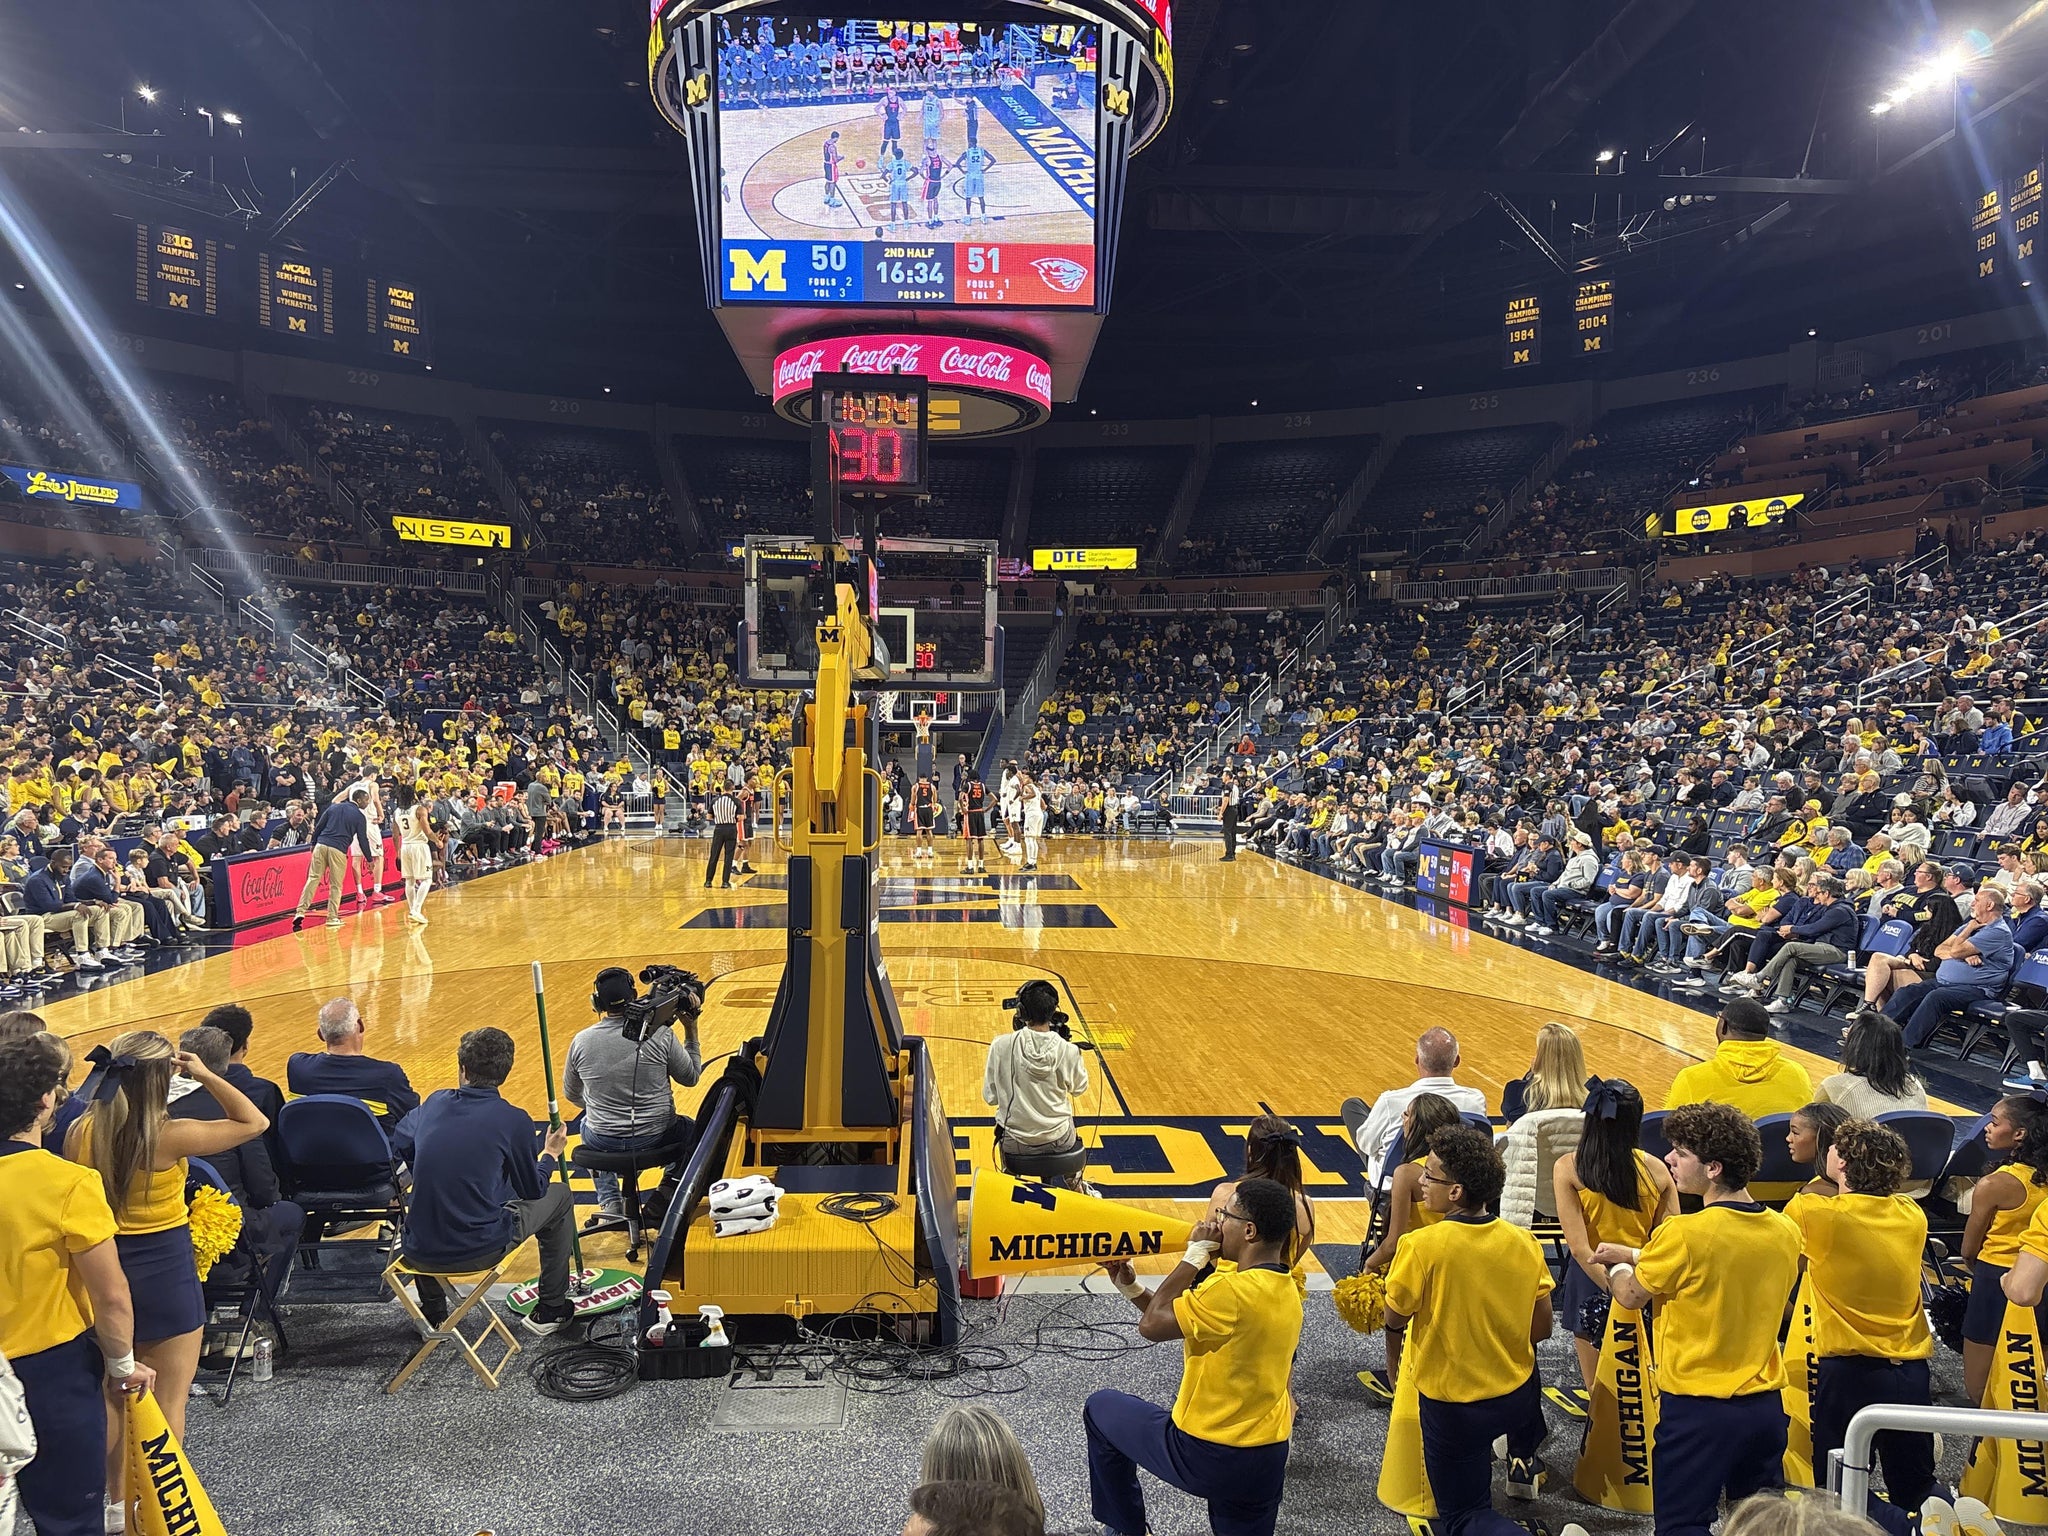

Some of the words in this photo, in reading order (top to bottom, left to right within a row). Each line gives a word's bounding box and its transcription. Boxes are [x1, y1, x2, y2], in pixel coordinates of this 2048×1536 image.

[686, 73, 707, 105] M
[1106, 83, 1130, 116] M
[2015, 210, 2039, 233] 1926
[1977, 231, 1996, 252] 1921
[2017, 239, 2033, 260] M
[157, 244, 199, 261] CHAMPIONS
[811, 246, 847, 271] 50
[884, 248, 905, 258] 2ND
[906, 248, 935, 258] HALF
[967, 247, 1000, 273] 51
[162, 263, 195, 277] WOMEN'S
[282, 261, 312, 276] NCAA
[729, 249, 787, 291] M
[876, 261, 945, 285] 16:34
[1979, 258, 1994, 278] M
[157, 271, 201, 287] GYMNASTICS
[276, 271, 318, 287] SEMI-FINALS
[808, 278, 837, 287] FOULS
[846, 277, 853, 287] 2
[966, 280, 995, 289] FOULS
[1003, 279, 1010, 289] 1
[169, 292, 189, 309] M
[281, 288, 312, 302] WOMEN'S
[387, 287, 415, 301] NCAA
[813, 289, 830, 298] TOL
[839, 288, 846, 298] 3
[898, 290, 922, 300] POSS
[972, 291, 989, 300] TOL
[997, 290, 1004, 300] 3
[1575, 293, 1613, 306] CHAMPIONS
[276, 296, 318, 312] GYMNASTICS
[390, 298, 412, 310] FINALS
[1508, 297, 1537, 311] NIT
[388, 313, 415, 325] WOMEN'S
[1505, 307, 1540, 320] CHAMPIONS
[288, 316, 307, 332] M
[383, 320, 420, 335] GYMNASTICS
[1578, 314, 1608, 331] 2004
[1509, 328, 1535, 343] 1984
[1917, 324, 1952, 345] 201
[393, 339, 410, 354] M
[1584, 337, 1600, 352] M
[939, 346, 1014, 382] Coca-Cola
[1513, 349, 1529, 364] M
[347, 370, 380, 387] 229
[1687, 368, 1721, 385] 236
[550, 400, 581, 414] 230
[842, 394, 910, 424] 16:34
[840, 427, 902, 482] 30
[65, 480, 119, 501] JEWELERS
[400, 521, 504, 543] NISSAN
[1052, 550, 1087, 563] DTE
[819, 628, 840, 643] M
[915, 652, 934, 669] 30
[2029, 738, 2039, 746] M
[1948, 759, 1958, 767] M
[1971, 759, 1981, 767] M
[971, 787, 982, 799] 35
[401, 817, 410, 830] 3
[1953, 837, 1965, 847] M
[1418, 854, 1431, 878] M
[1452, 860, 1460, 874] 51
[241, 865, 284, 905] Coca-Cola
[989, 1230, 1164, 1262] MICHIGAN
[1612, 1318, 1650, 1487] MICHIGAN
[2006, 1330, 2048, 1498] MICIGAN
